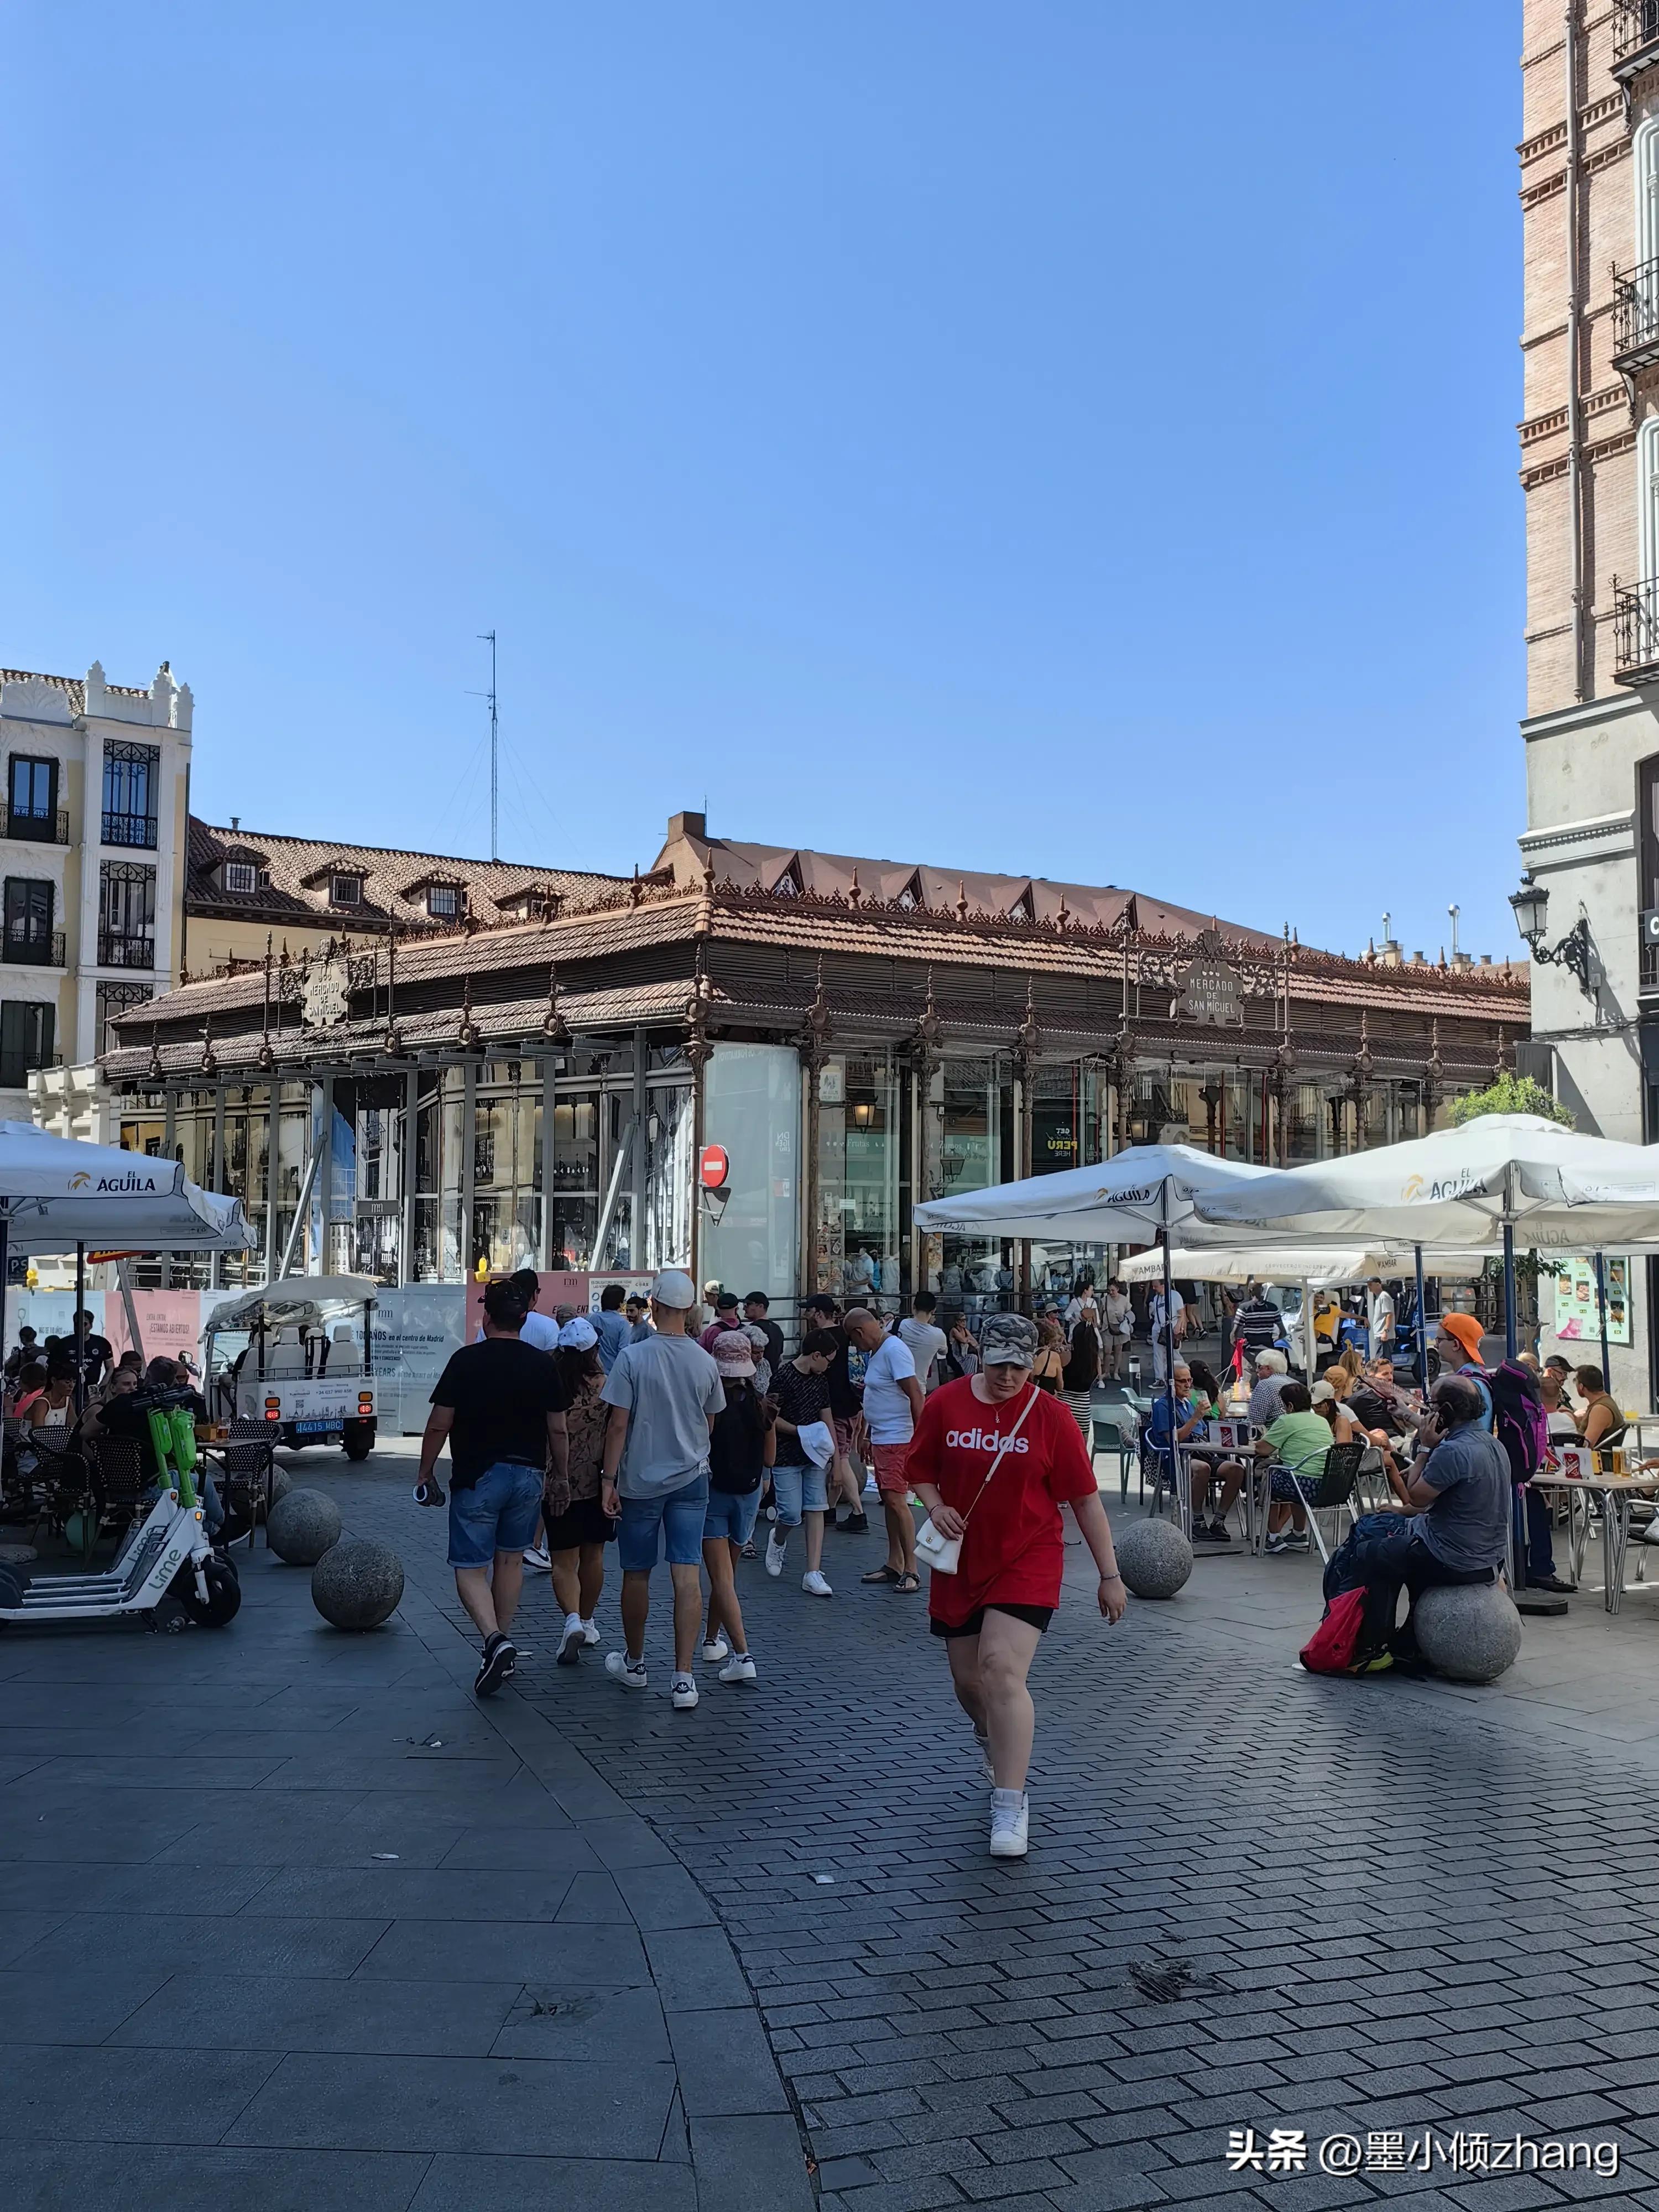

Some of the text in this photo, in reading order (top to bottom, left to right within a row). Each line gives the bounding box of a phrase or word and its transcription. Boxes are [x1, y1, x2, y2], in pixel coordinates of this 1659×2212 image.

[309, 981, 340, 997] MERCADO
[1190, 978, 1233, 992] MERCADO
[320, 995, 328, 1004] DE
[1188, 999, 1204, 1011] SAN
[309, 1002, 342, 1017] SAN MIGUEL
[847, 1139, 870, 1147] Frutas
[1462, 1167, 1471, 1178] EL
[96, 1176, 156, 1192] ÁGUILA
[426, 1334, 444, 1342] Madrid
[302, 1421, 342, 1432] 4415 MBC
[946, 1428, 1029, 1453] adidas
[148, 1549, 181, 1589] Lime
